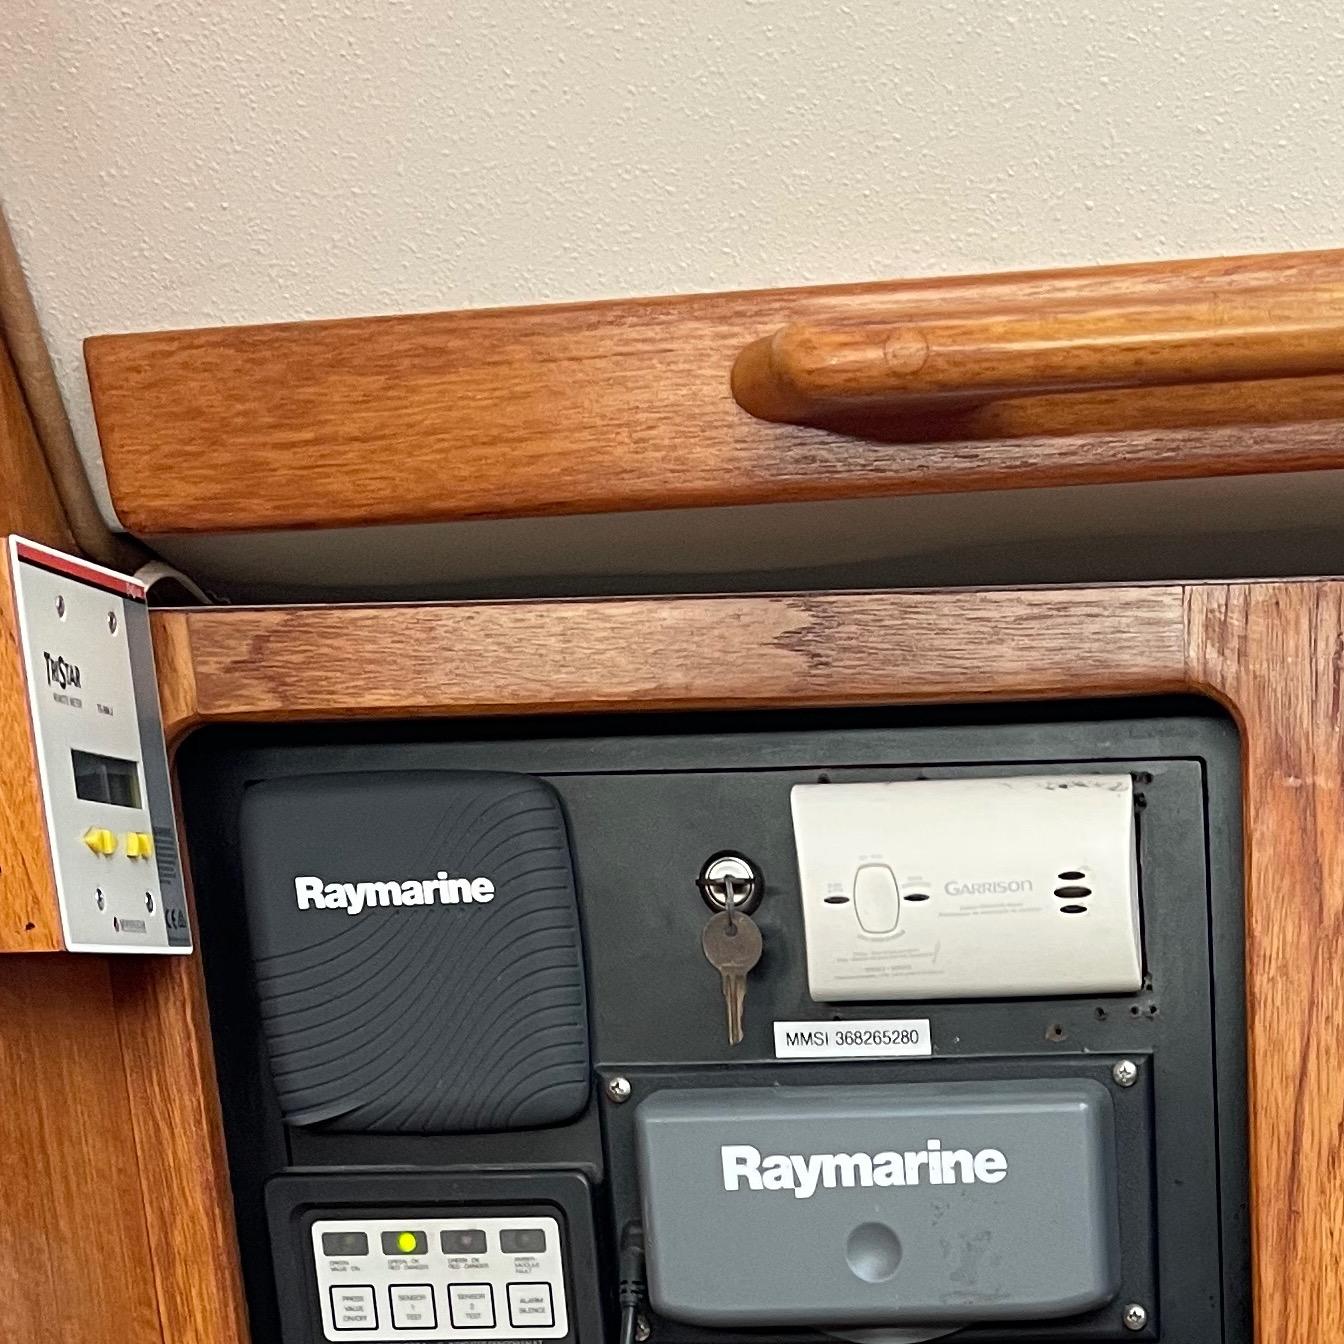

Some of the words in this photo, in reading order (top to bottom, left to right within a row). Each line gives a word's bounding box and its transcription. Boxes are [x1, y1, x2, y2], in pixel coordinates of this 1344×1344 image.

[295, 871, 494, 914] Raymarine
[786, 1032, 829, 1046] MMSI
[836, 1029, 919, 1046] 368265280
[721, 1139, 1008, 1198] Raymarine
